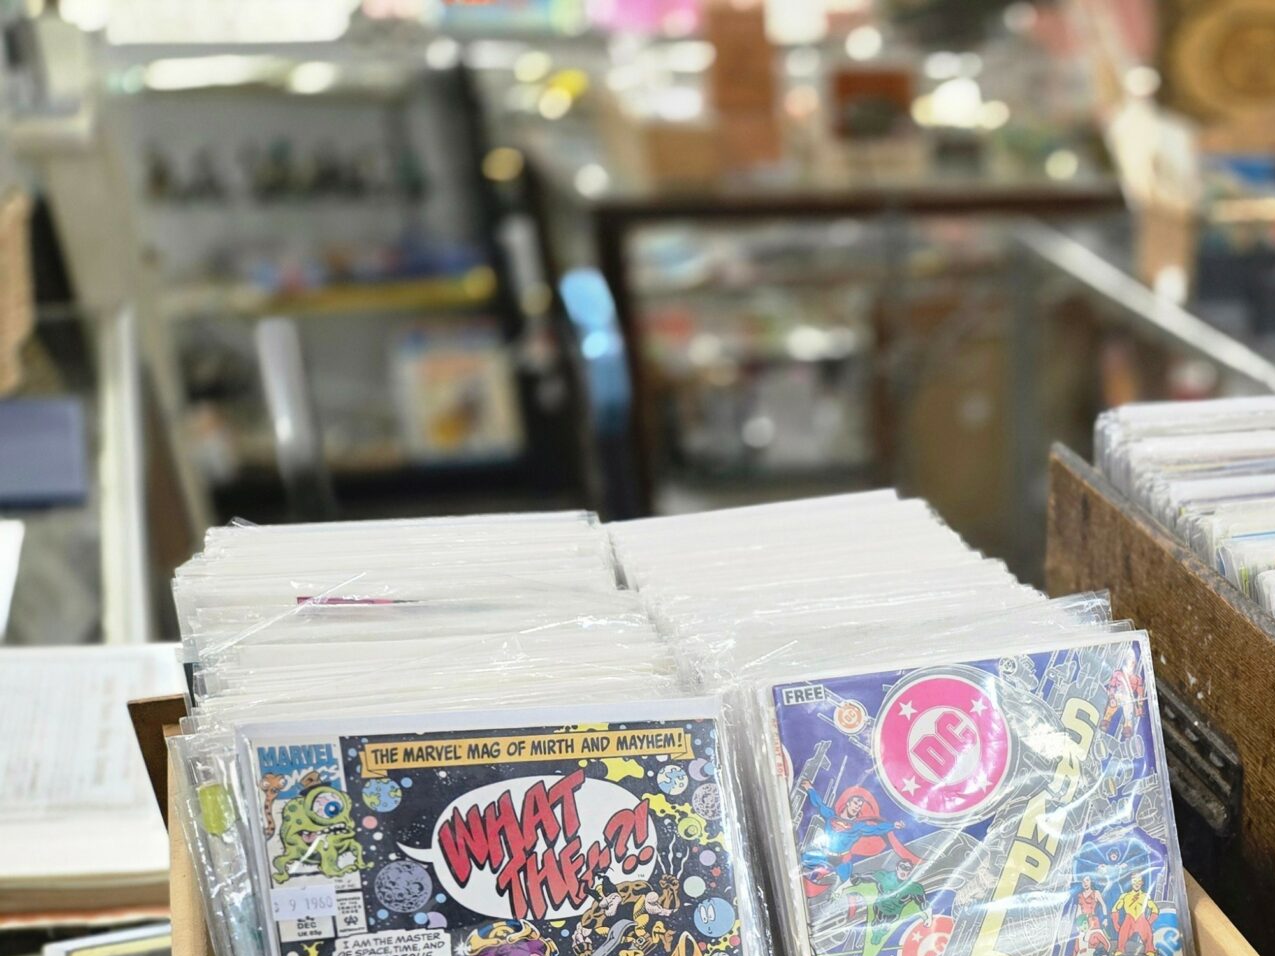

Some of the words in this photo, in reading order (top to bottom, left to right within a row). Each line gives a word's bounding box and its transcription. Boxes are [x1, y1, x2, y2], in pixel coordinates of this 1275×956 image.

[784, 686, 824, 704] FREE
[371, 747, 399, 765] THE
[403, 744, 462, 763] MARVEL
[466, 741, 501, 760] MAG
[506, 740, 526, 757] OF
[530, 738, 575, 756] MIRTH
[581, 736, 611, 754] AND
[616, 732, 684, 751] MAYHEM!
[912, 706, 977, 783] DC
[257, 743, 335, 768] MARVEL
[438, 769, 586, 889] WHAT
[297, 921, 318, 930] DEC
[342, 940, 350, 950] I
[352, 939, 372, 949] AM
[373, 936, 394, 946] THE
[395, 932, 441, 944] MASTER
[422, 941, 446, 950] AND
